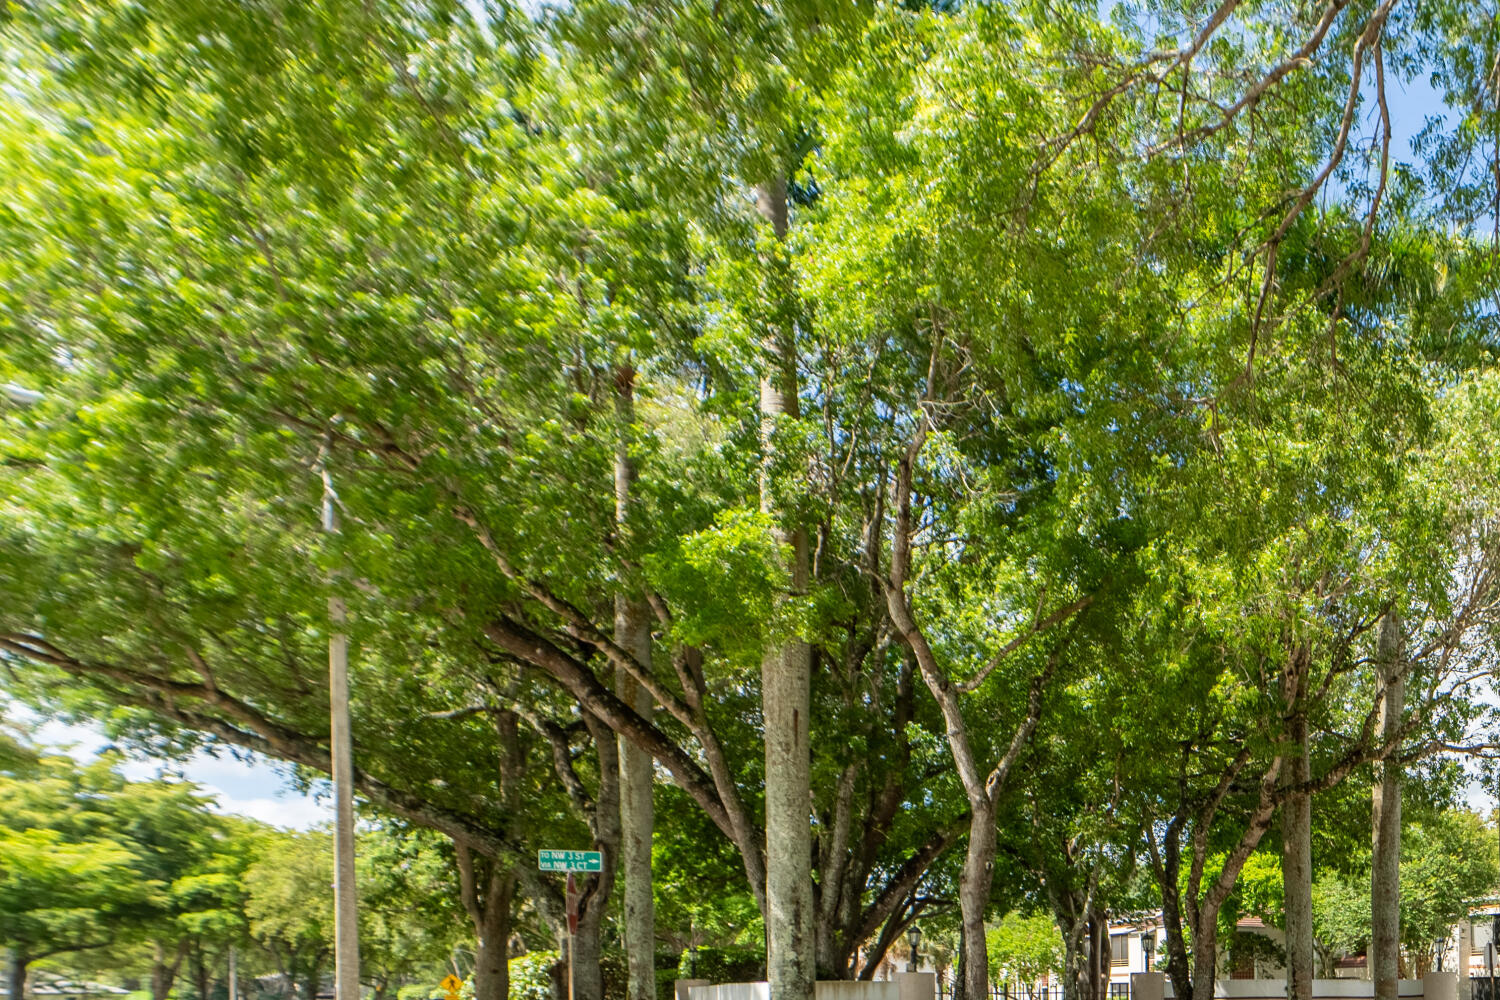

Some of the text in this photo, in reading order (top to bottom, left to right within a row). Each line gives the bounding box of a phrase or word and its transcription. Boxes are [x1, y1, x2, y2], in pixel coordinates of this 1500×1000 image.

[551, 852, 565, 860] NW
[574, 852, 585, 860] ST
[553, 861, 567, 870] NW
[576, 861, 588, 870] CT
